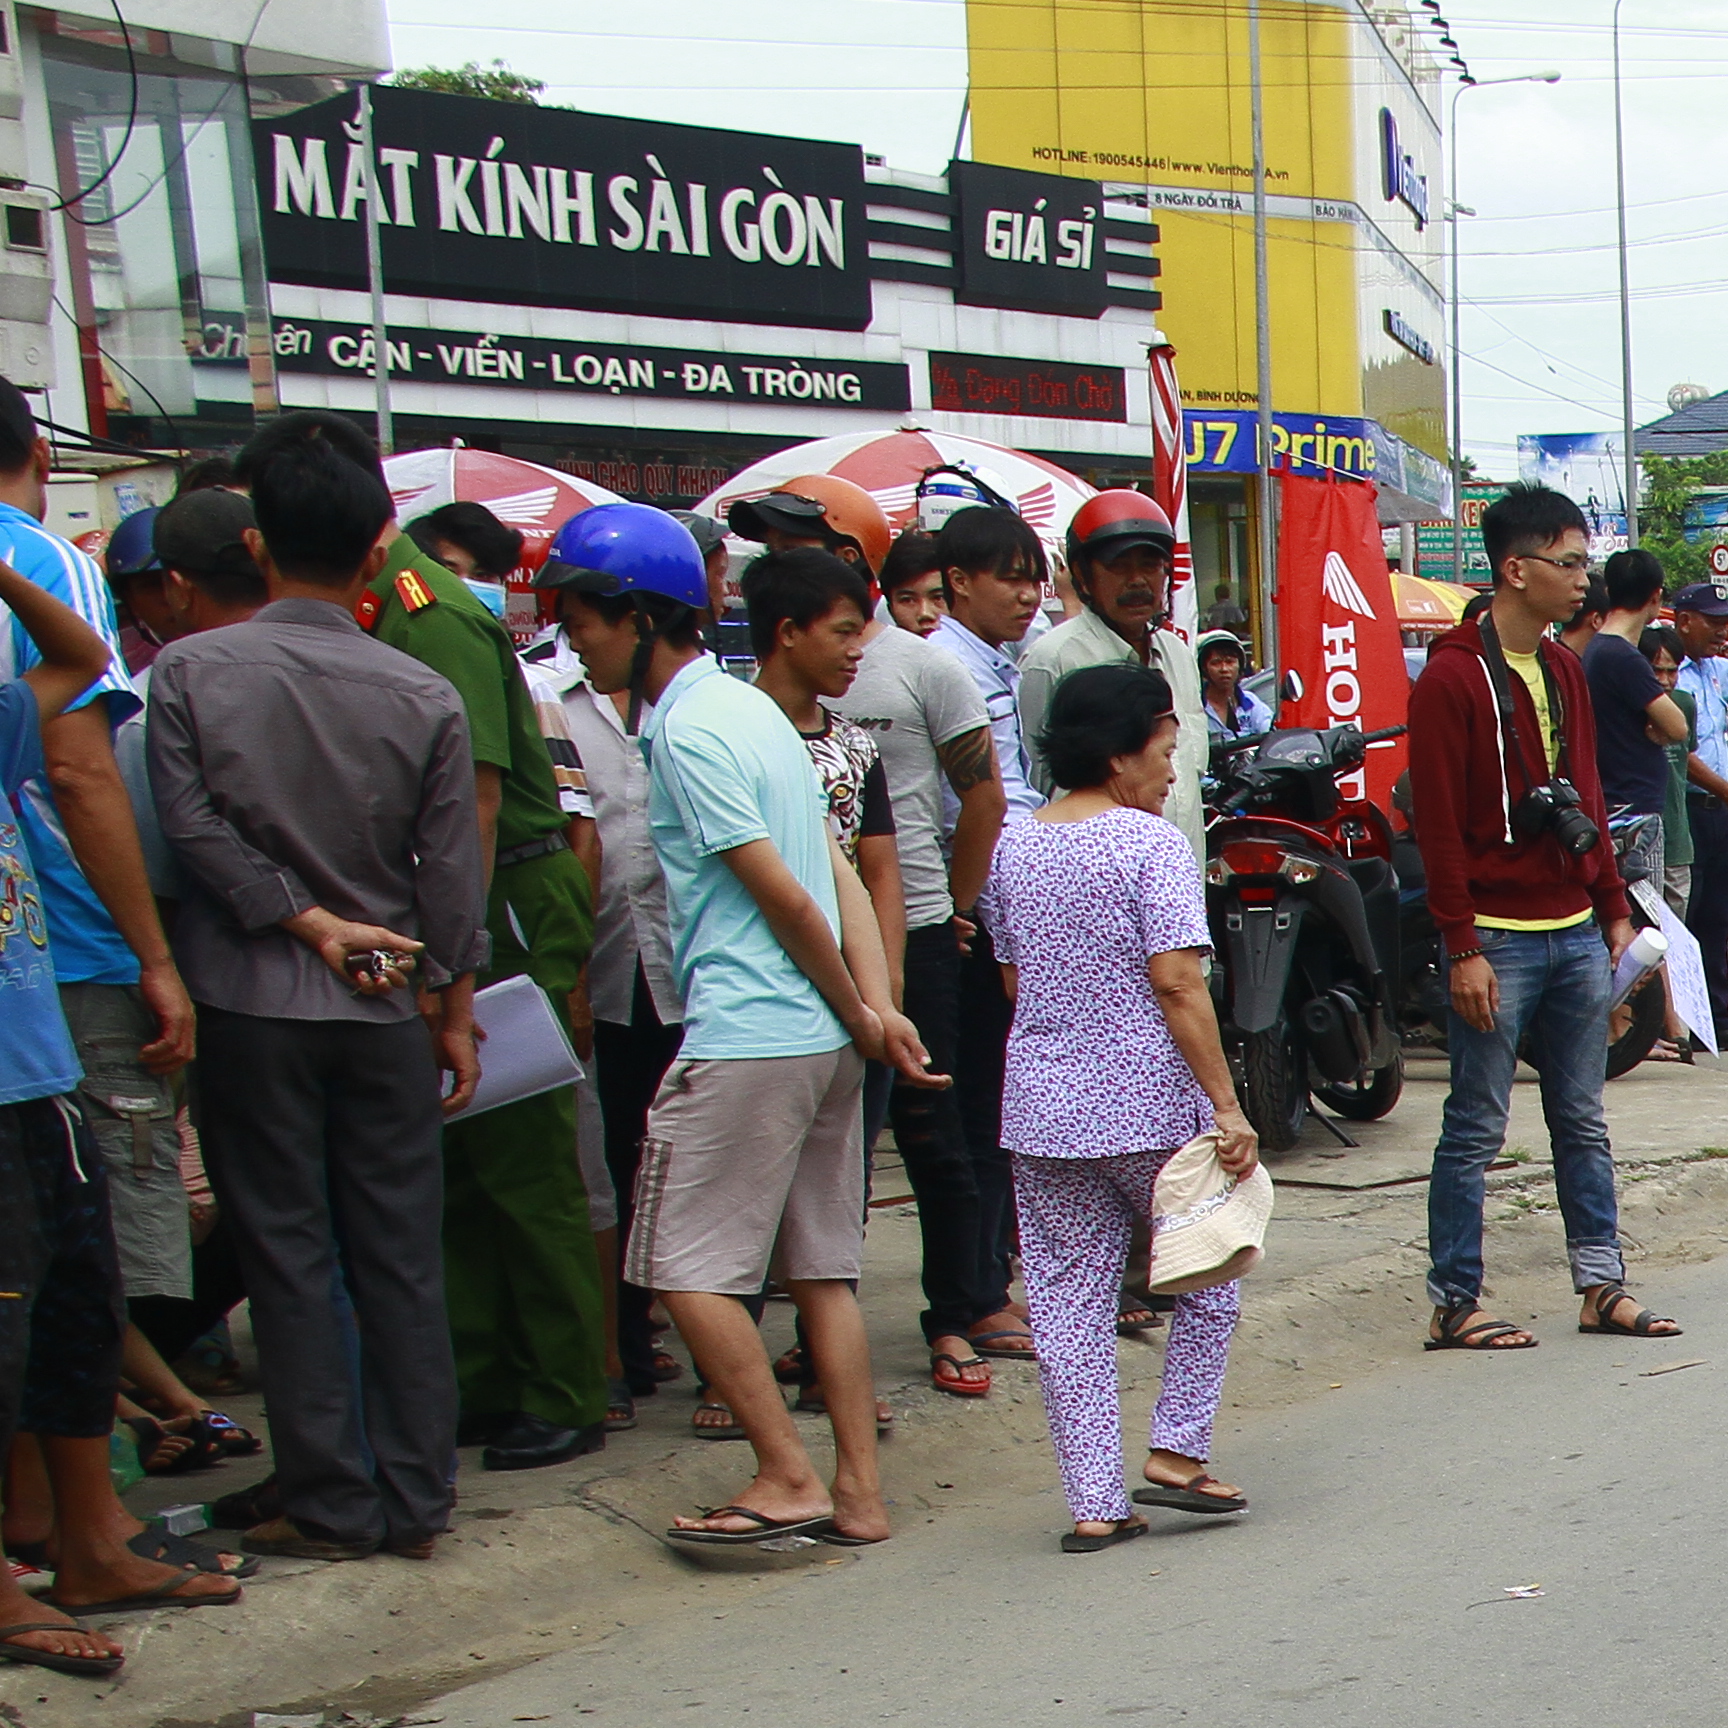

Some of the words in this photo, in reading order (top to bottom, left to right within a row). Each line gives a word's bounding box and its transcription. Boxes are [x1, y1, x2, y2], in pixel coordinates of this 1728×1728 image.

[272, 103, 419, 228] MẮT
[433, 135, 599, 247] KÍNH
[607, 153, 711, 258] SÀI
[719, 165, 845, 271] GÒN
[1033, 147, 1092, 164] HOTLINE:
[985, 198, 1048, 265] GIÁ
[1055, 205, 1097, 270] SỈ
[1154, 192, 1162, 204] 8
[1164, 191, 1194, 206] NGÀY
[327, 328, 413, 378] CẬN
[437, 333, 525, 381] VIỄN
[551, 352, 656, 396] LOẠN
[681, 362, 735, 395] ĐA
[741, 360, 863, 403] TRÒNG
[1185, 420, 1239, 466] J7
[1255, 422, 1377, 473] Prime
[1322, 620, 1366, 801] HOD
